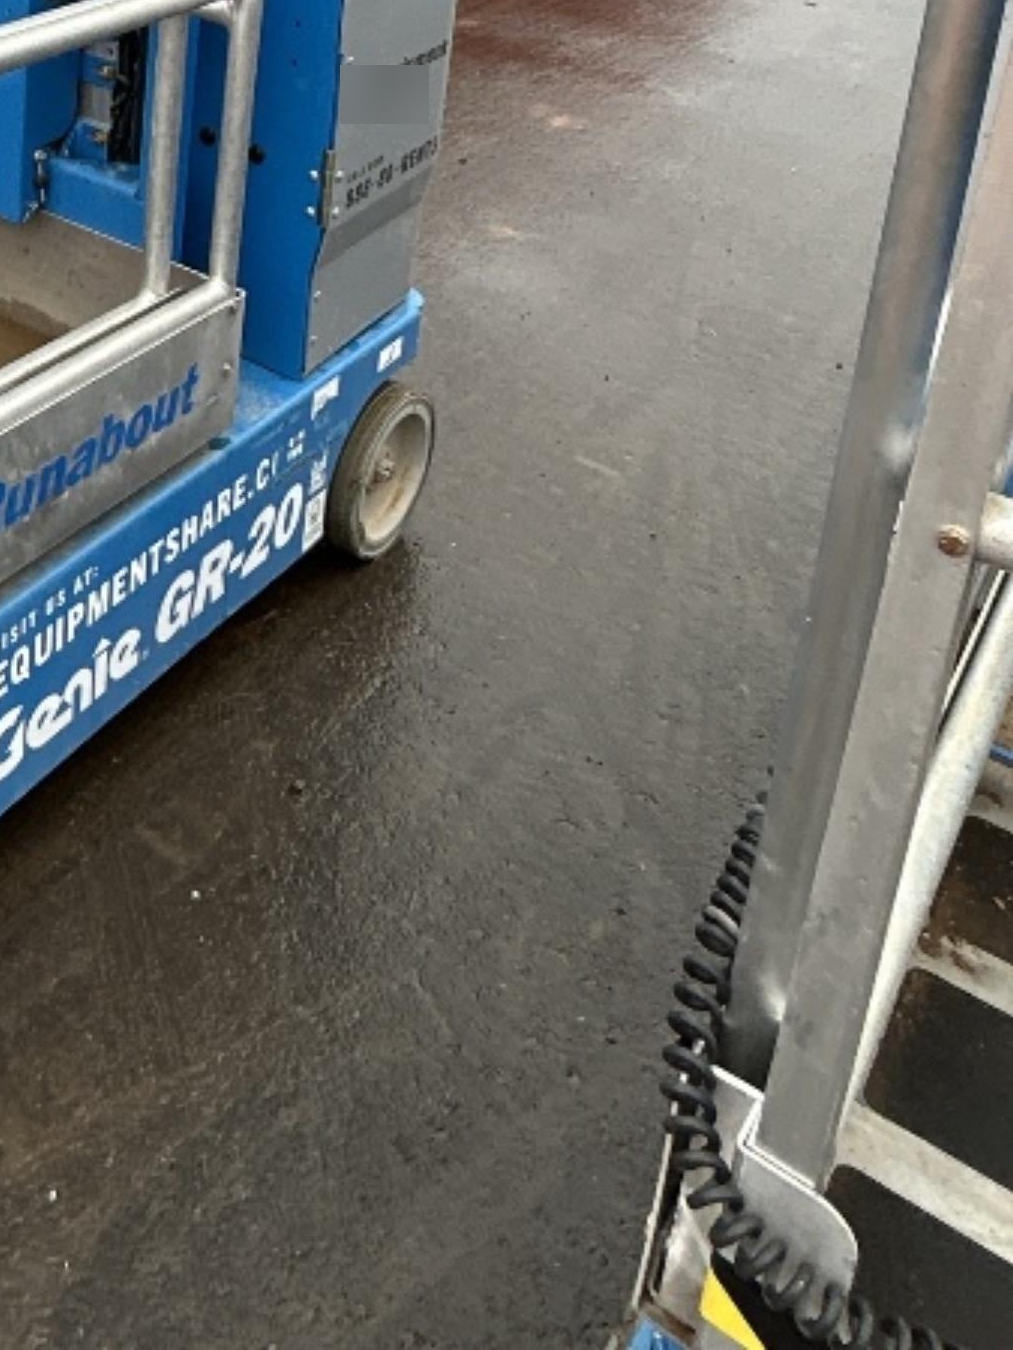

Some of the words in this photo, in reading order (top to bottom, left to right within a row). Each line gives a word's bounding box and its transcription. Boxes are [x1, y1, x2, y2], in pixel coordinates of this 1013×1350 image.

[45, 588, 67, 617] US
[73, 566, 99, 595] AT:
[155, 482, 303, 644] GR-20
